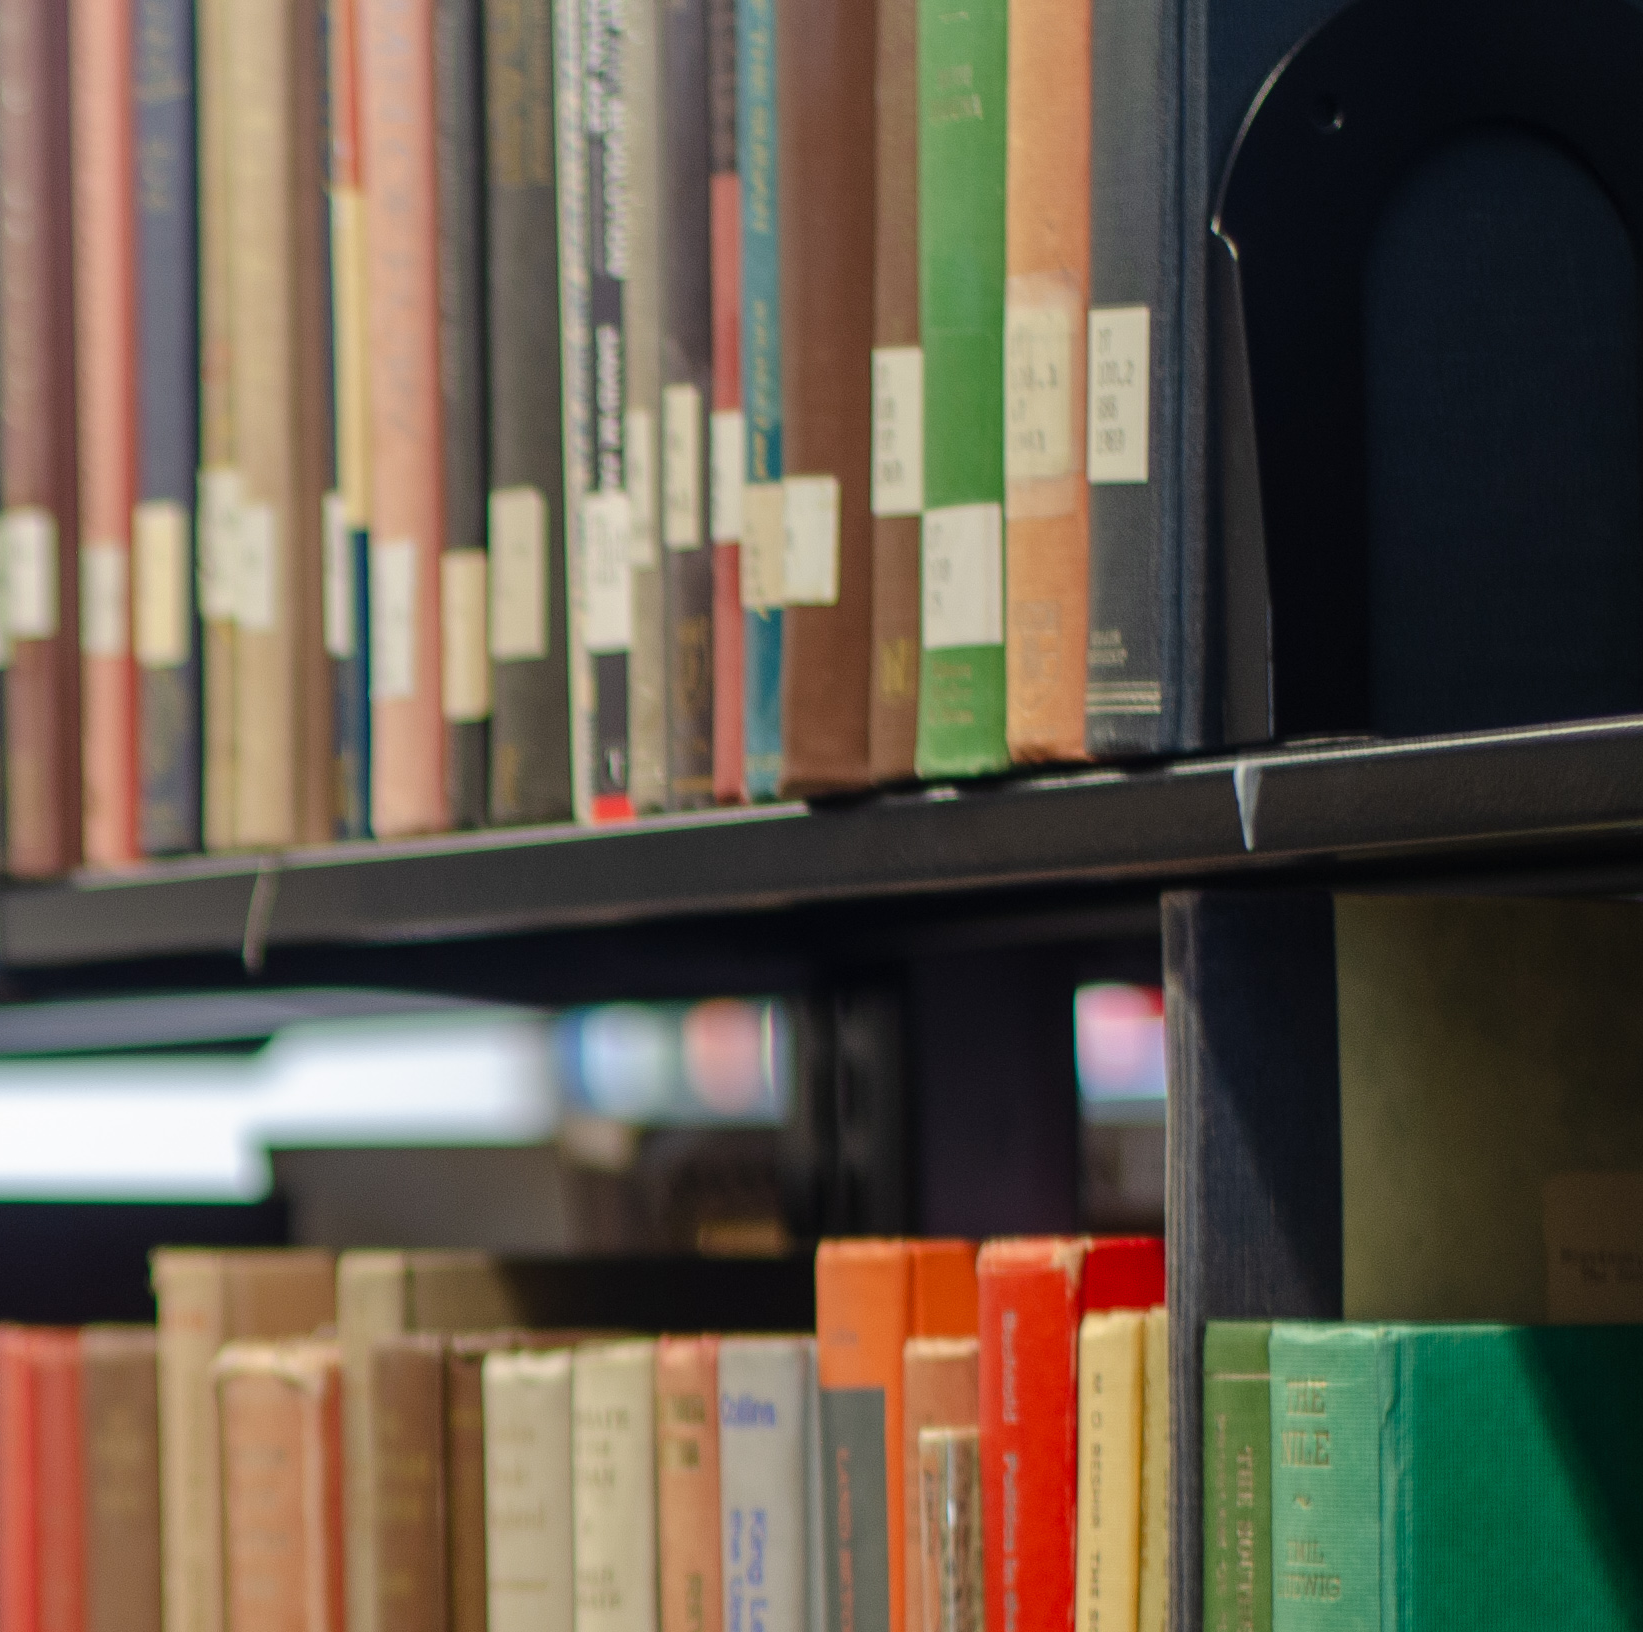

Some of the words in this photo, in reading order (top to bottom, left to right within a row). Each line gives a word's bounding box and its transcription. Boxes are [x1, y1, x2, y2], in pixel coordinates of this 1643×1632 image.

[1286, 1376, 1327, 1417] THE
[1281, 1429, 1331, 1468] NILE
[1089, 1552, 1100, 1599] THE
